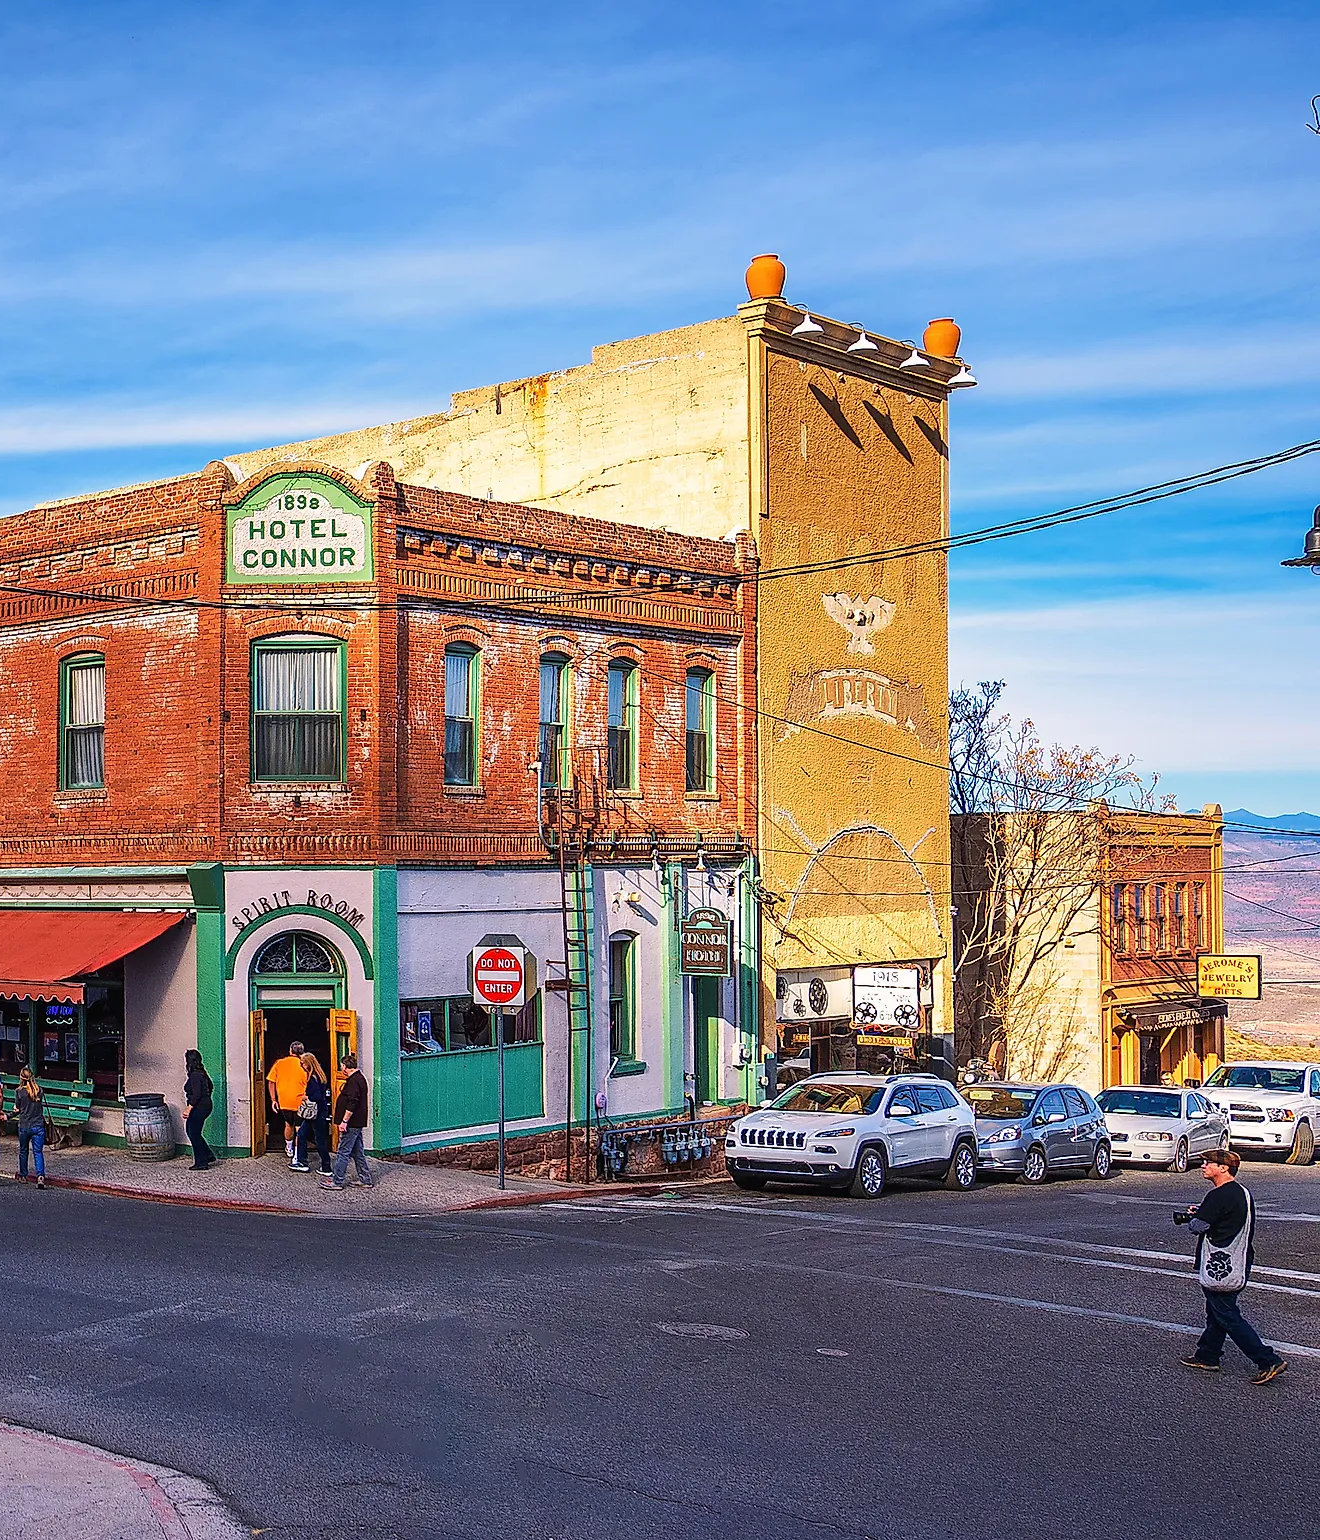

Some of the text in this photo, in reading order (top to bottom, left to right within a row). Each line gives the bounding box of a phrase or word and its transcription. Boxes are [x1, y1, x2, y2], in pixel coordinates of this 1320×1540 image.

[278, 494, 320, 511] 1898
[248, 518, 348, 540] HOTEL
[242, 547, 356, 569] CONNOR
[822, 676, 897, 712] LIBERTY
[232, 889, 366, 931] SPIRIT ROOM
[681, 933, 728, 945] CONNOR
[686, 950, 724, 962] HOTEL
[481, 959, 516, 968] DO NOT
[1203, 958, 1253, 973] JEROME'S
[1201, 974, 1255, 983] JEWELRY
[484, 983, 513, 993] ENTER
[1214, 988, 1243, 996] GIFTS
